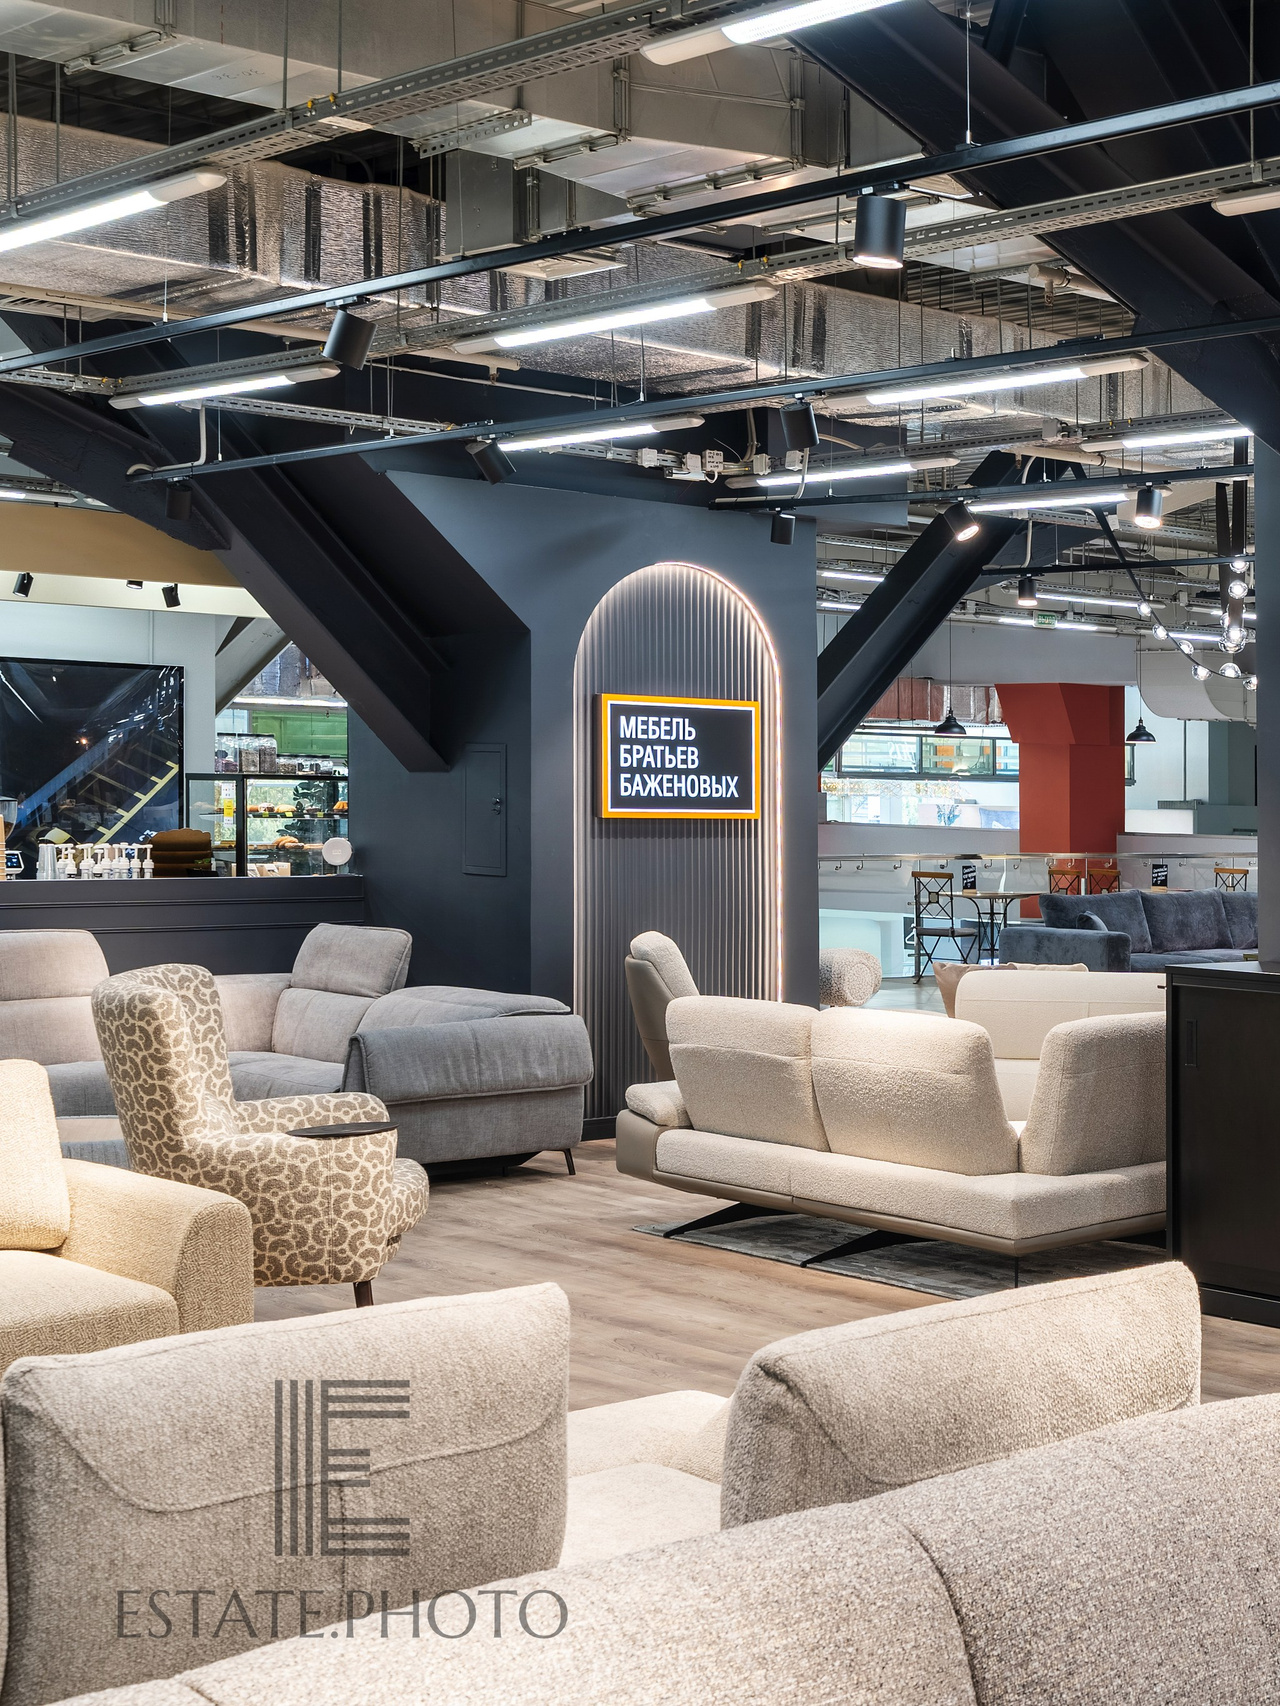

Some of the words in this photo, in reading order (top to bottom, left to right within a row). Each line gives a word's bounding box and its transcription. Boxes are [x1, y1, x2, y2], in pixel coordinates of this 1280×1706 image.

[619, 715, 697, 741] МЕБЕЛЬ
[619, 744, 700, 769] БРАТЬЕВ
[619, 773, 740, 798] БАЖЕНОВЫХ
